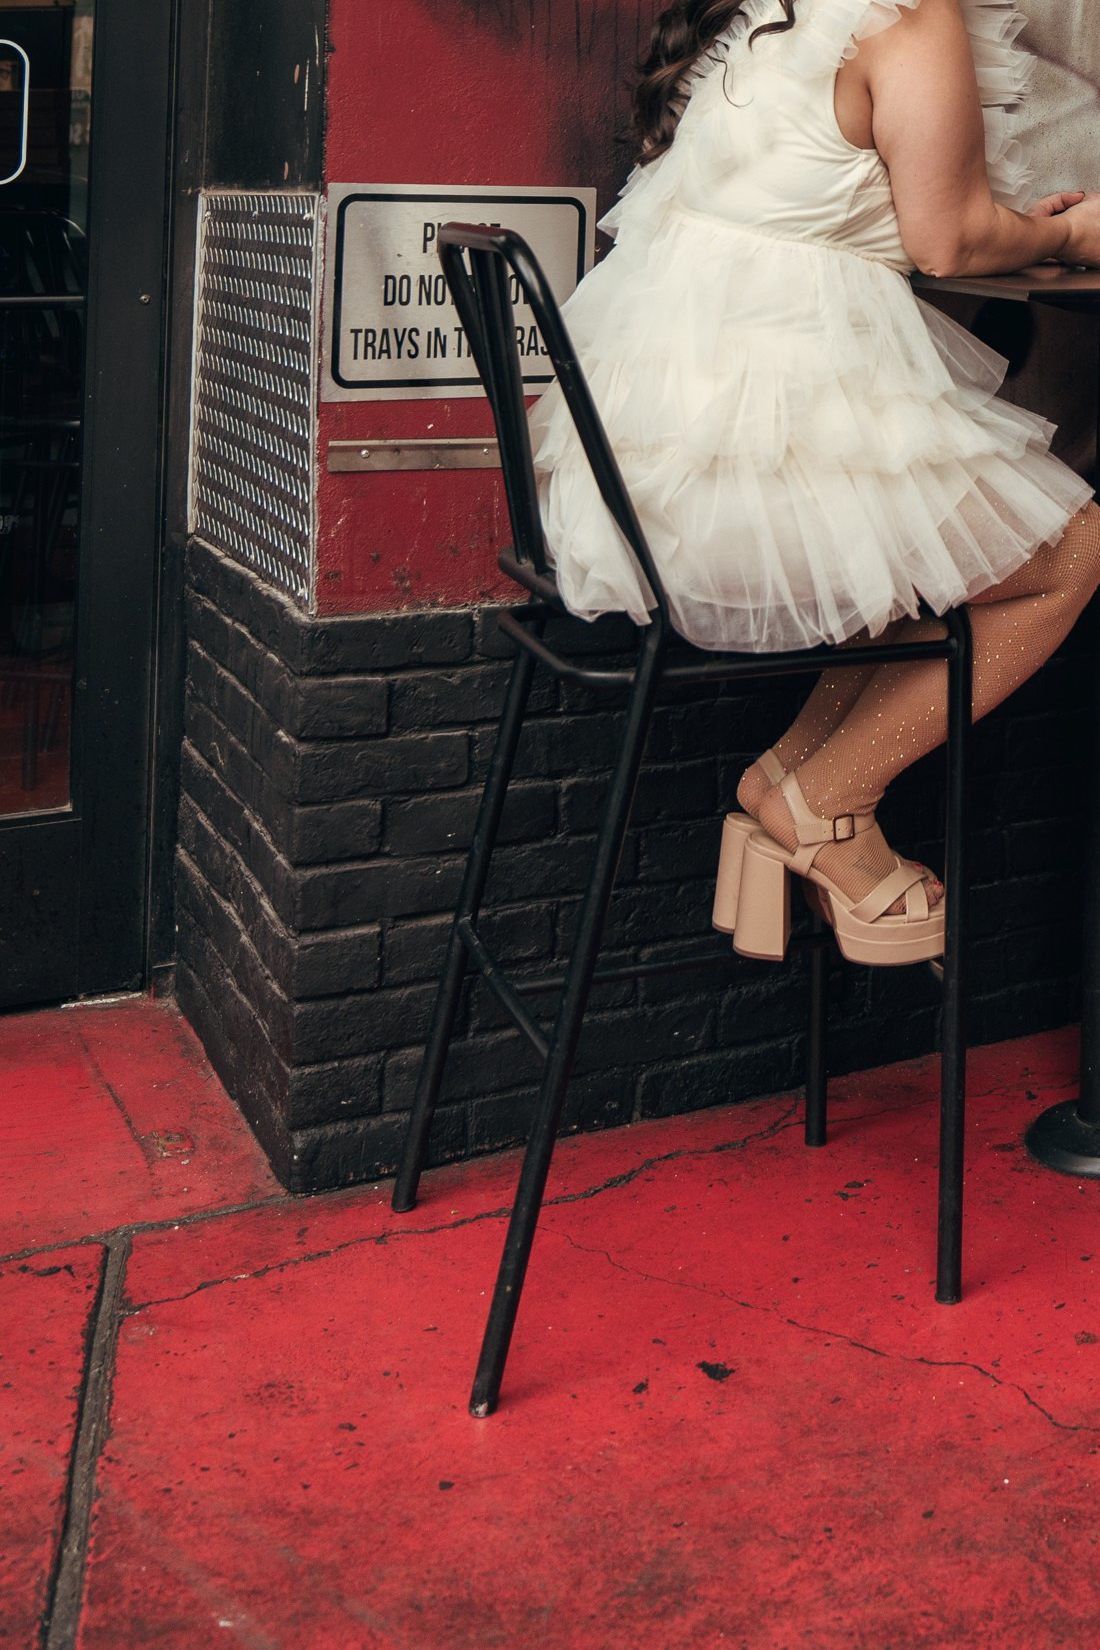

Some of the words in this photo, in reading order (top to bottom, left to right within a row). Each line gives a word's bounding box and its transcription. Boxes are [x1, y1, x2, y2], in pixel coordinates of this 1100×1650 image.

[383, 274, 412, 306] DO
[418, 274, 456, 306] NO
[350, 327, 420, 360] TRAYS
[426, 327, 447, 359] IN
